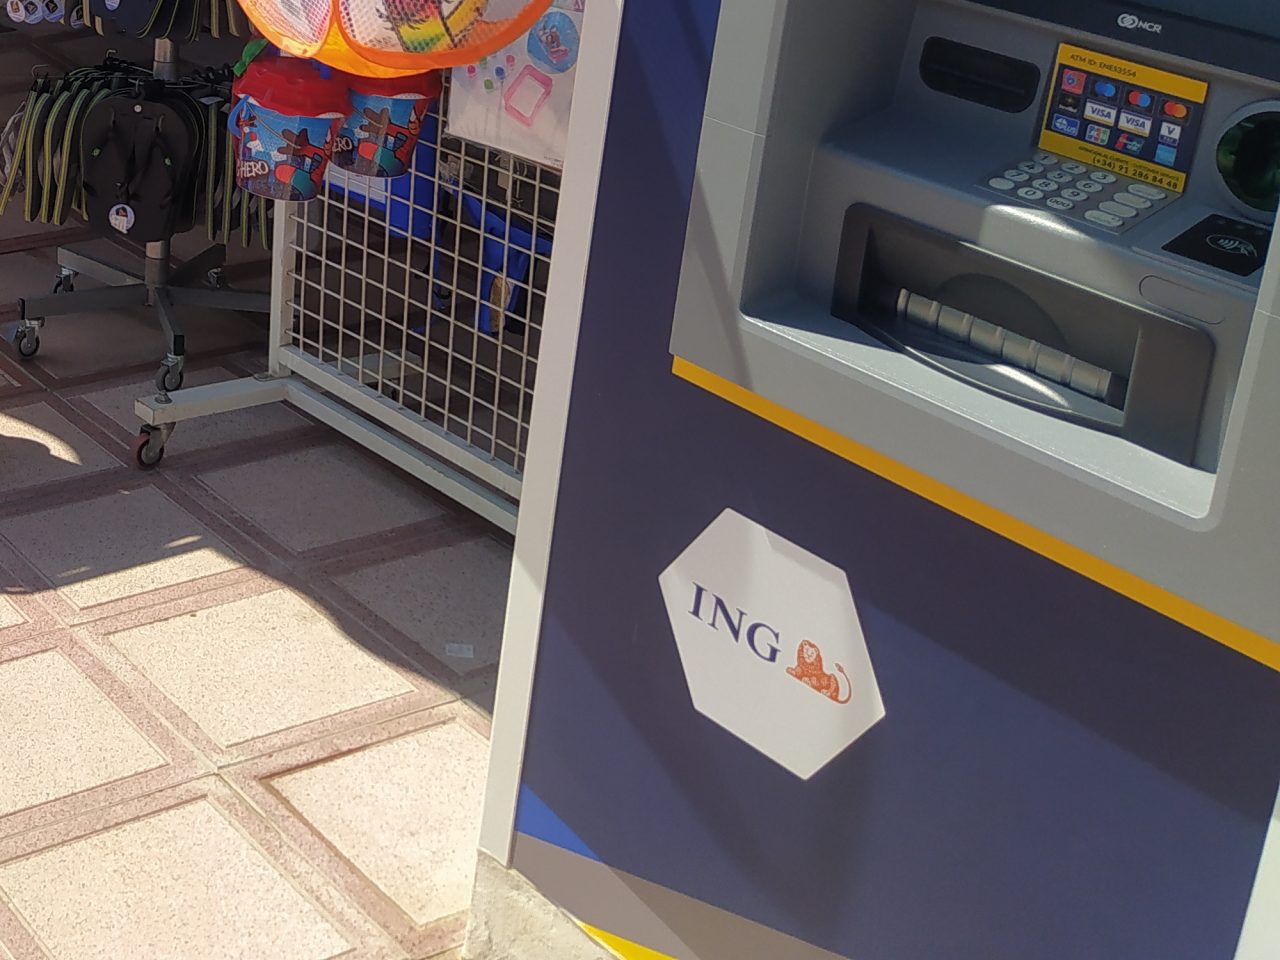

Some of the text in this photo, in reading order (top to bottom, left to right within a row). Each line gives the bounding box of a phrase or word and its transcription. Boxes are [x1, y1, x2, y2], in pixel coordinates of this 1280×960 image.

[1137, 20, 1163, 34] NCR
[1070, 53, 1088, 65] ATM
[1090, 105, 1113, 120] VISA
[1124, 116, 1147, 131] VISA
[1092, 154, 1116, 169] (+34)
[1118, 163, 1130, 174] 91
[687, 581, 781, 664] ING
